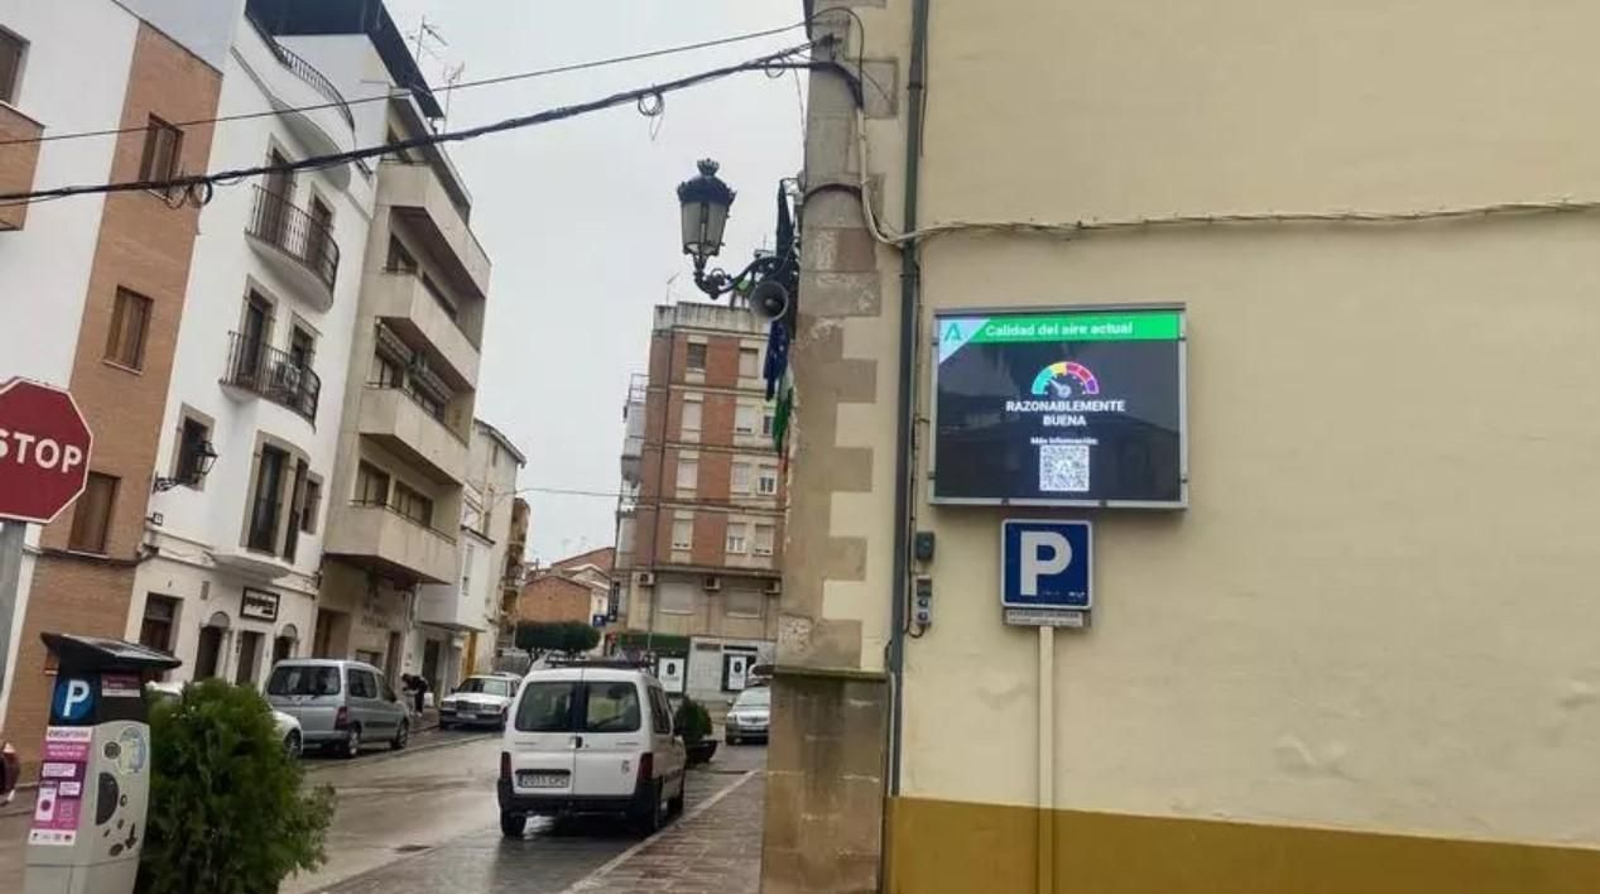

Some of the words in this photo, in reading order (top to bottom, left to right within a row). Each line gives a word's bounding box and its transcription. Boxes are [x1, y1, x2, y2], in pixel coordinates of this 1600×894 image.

[985, 322, 1034, 337] Calidad
[1038, 322, 1058, 336] del
[1062, 323, 1087, 335] aire
[1091, 321, 1133, 335] actual
[1005, 400, 1126, 412] RAZONABLEMENTE
[1042, 414, 1087, 426] BUENA
[1020, 531, 1073, 596] P
[63, 679, 90, 717] P
